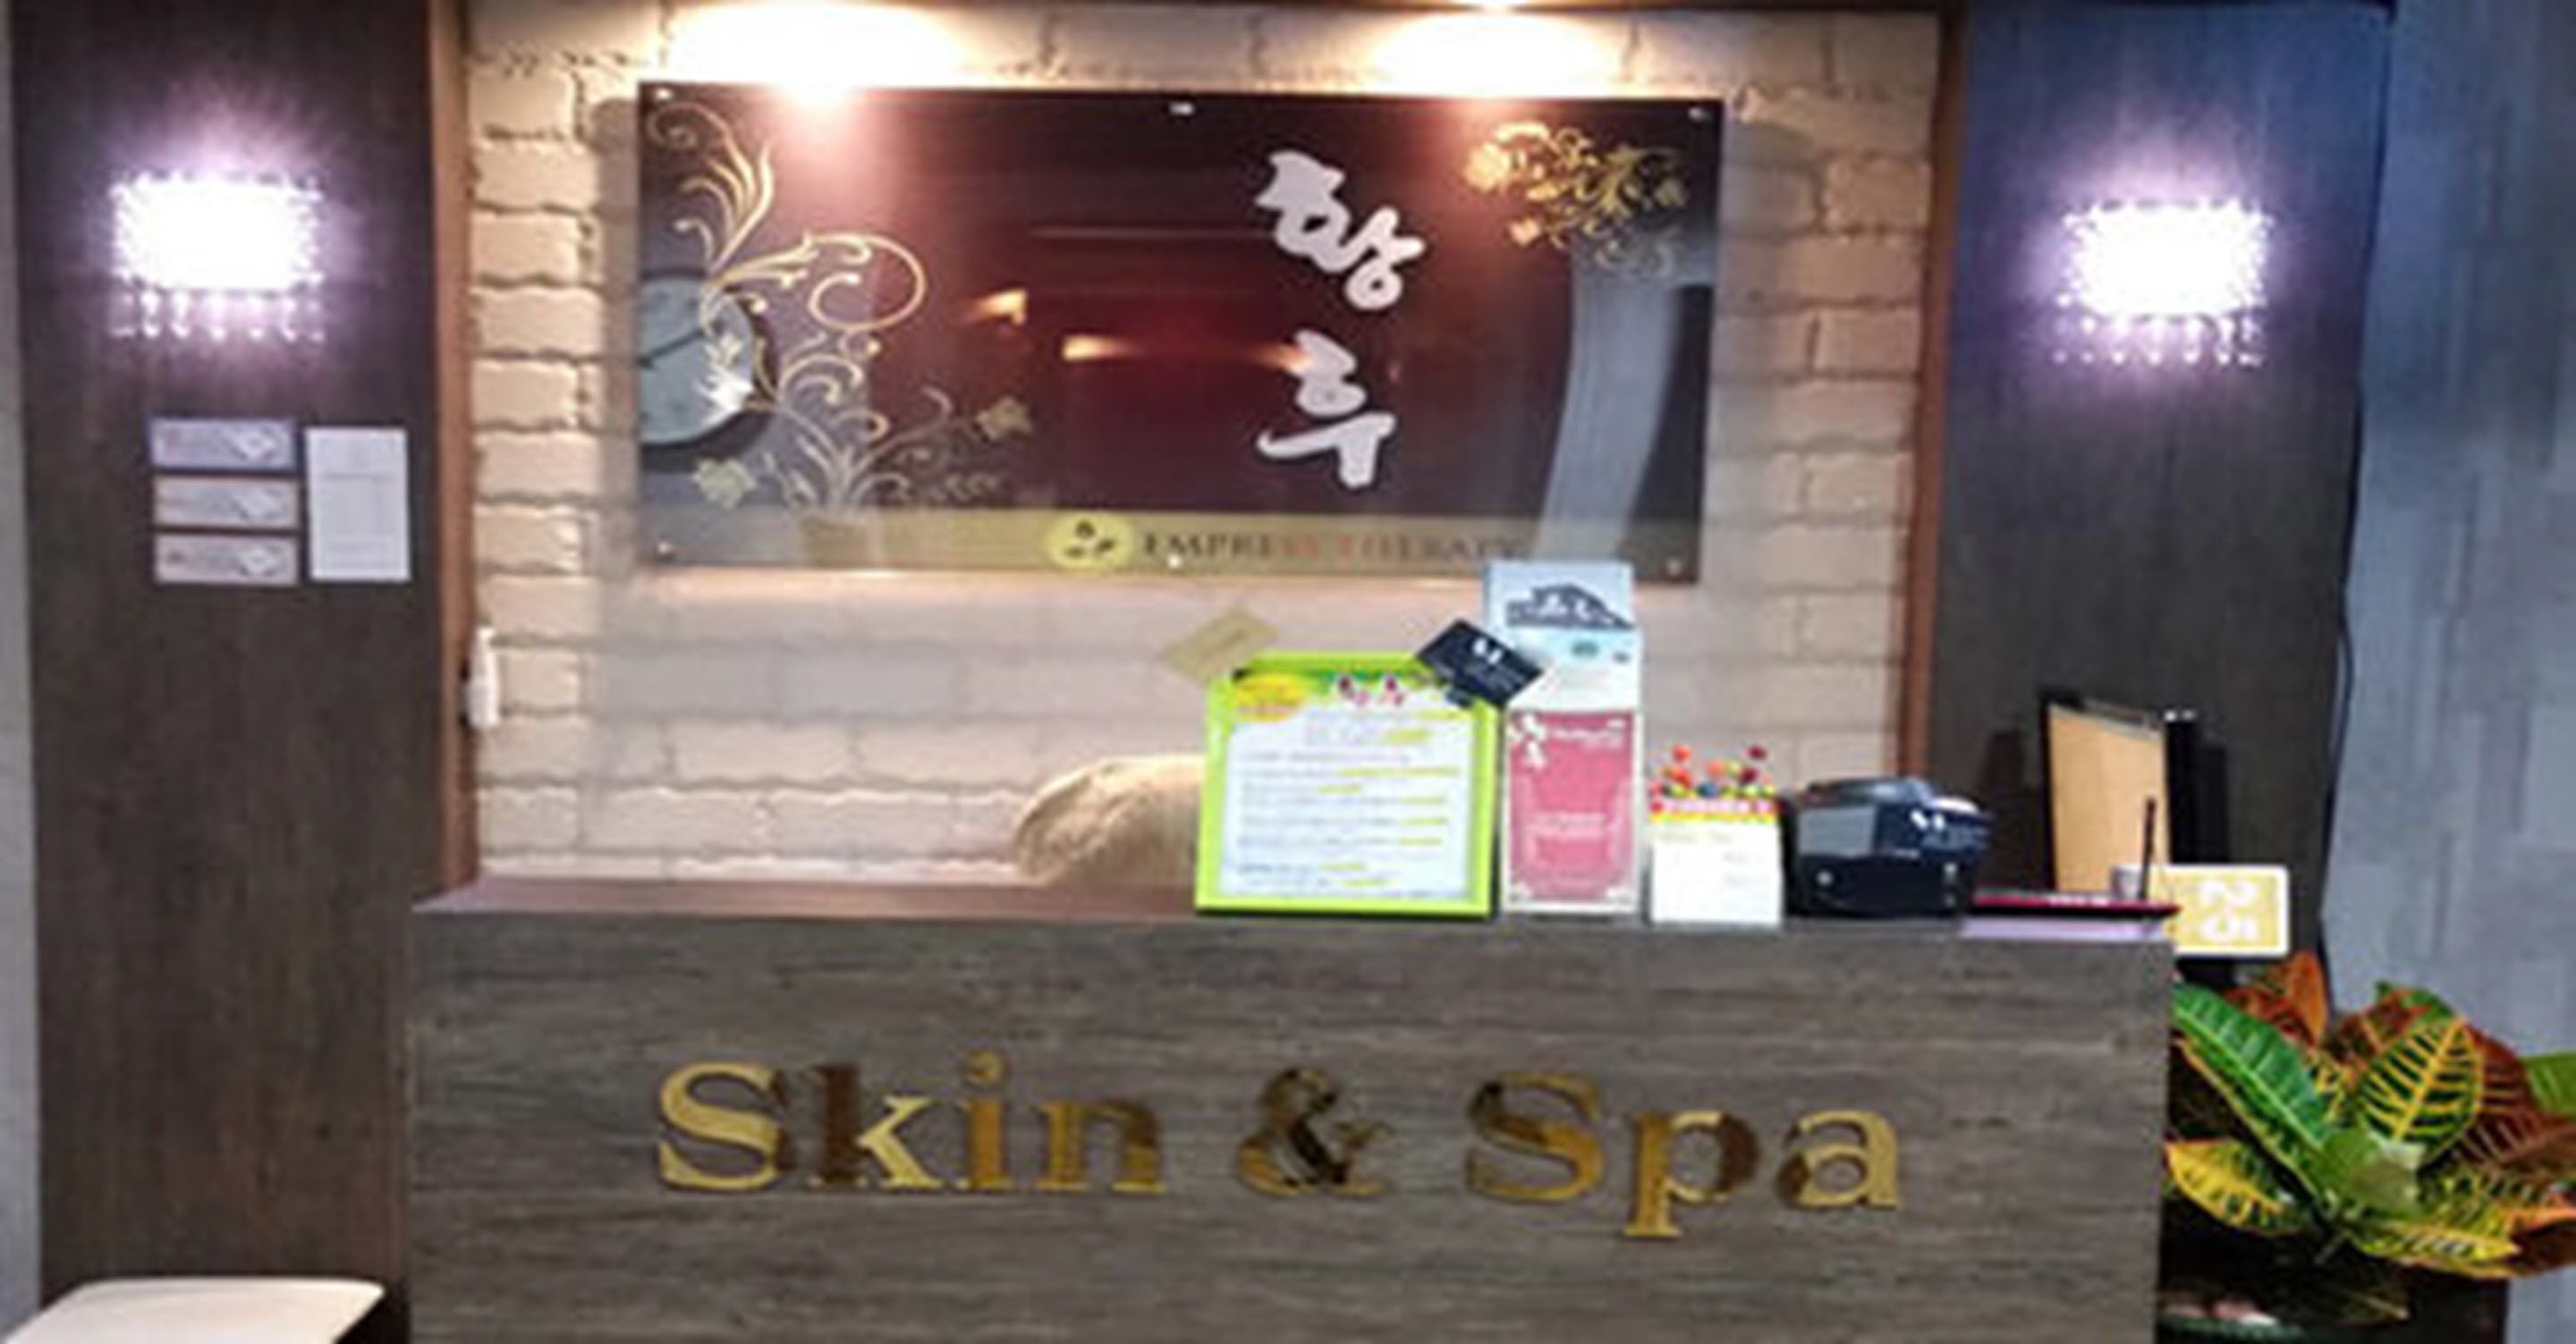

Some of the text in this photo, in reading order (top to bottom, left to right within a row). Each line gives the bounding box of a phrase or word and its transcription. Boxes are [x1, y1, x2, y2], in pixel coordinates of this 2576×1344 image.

[1256, 149, 1425, 488] 황후
[657, 1050, 1902, 1238] Skin & Spa
